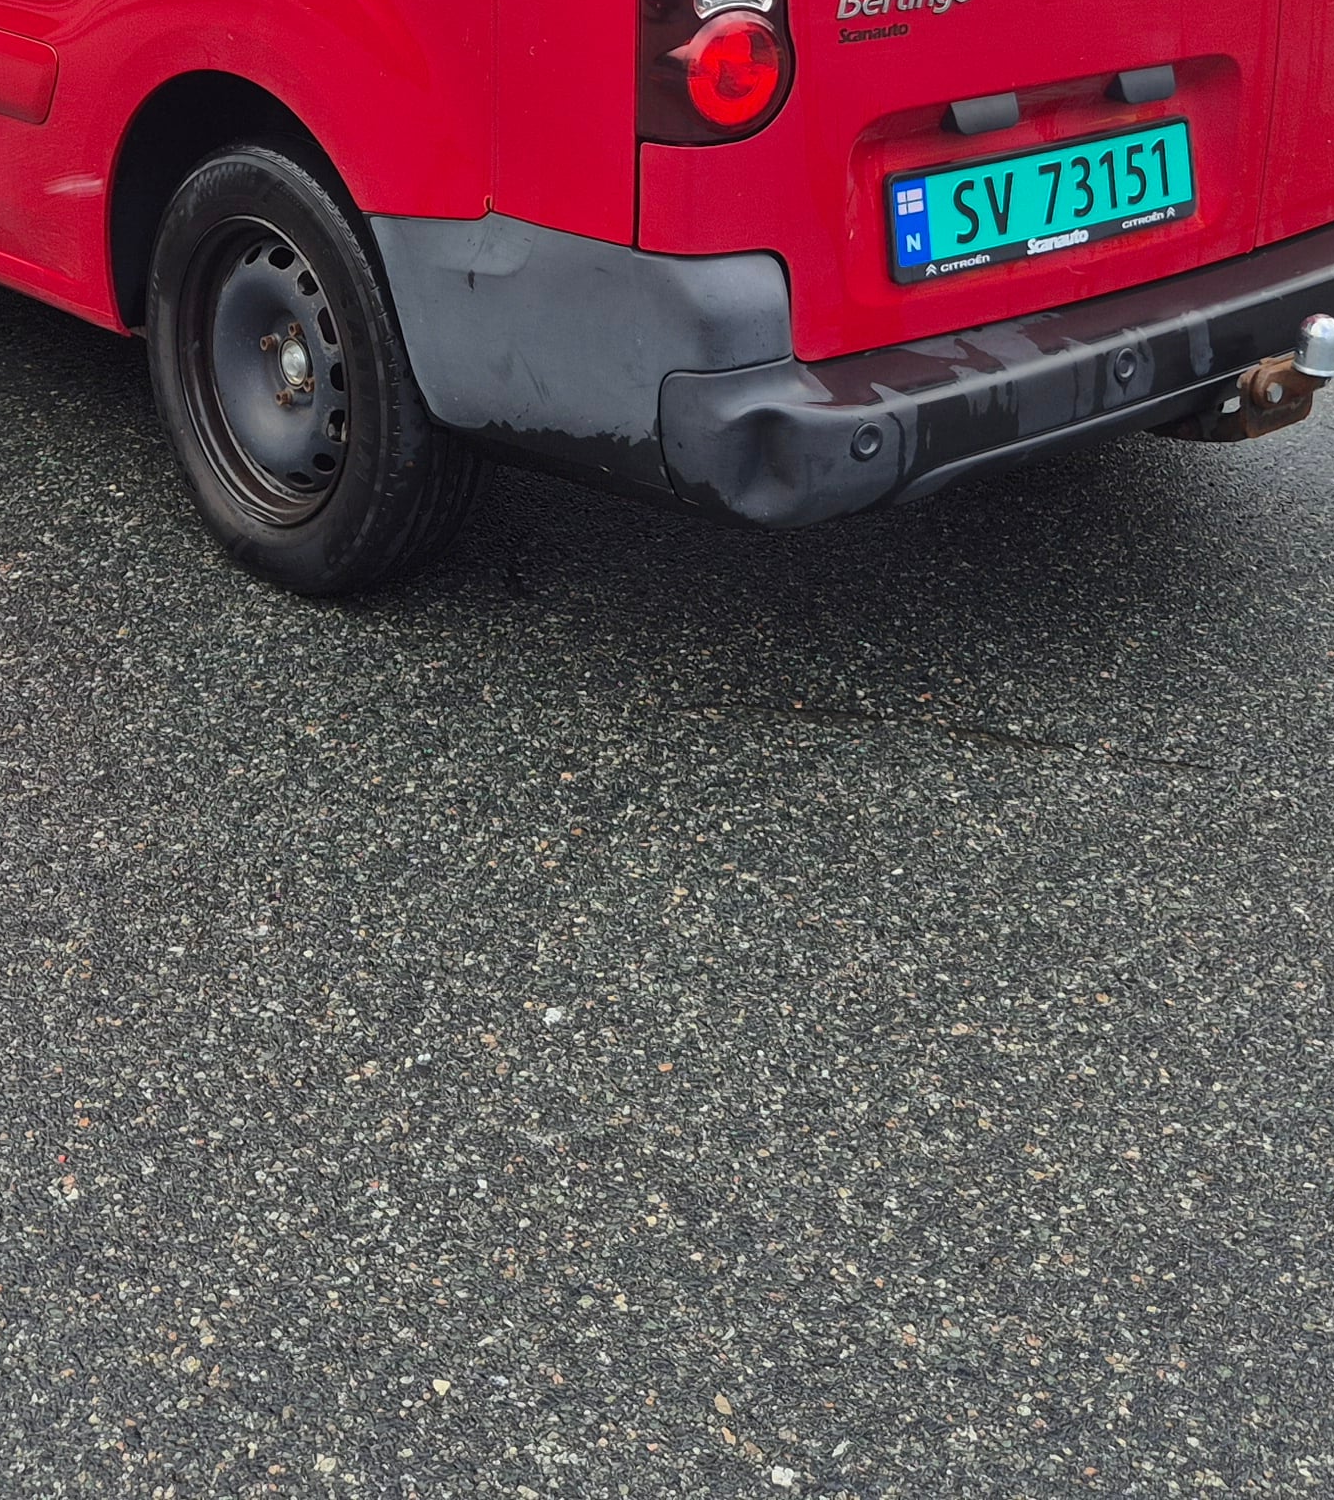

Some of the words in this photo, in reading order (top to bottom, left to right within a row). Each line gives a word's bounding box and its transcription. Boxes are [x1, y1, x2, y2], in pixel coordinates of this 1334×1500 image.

[838, 23, 909, 43] Scanauto
[952, 172, 1014, 245] SV
[1038, 138, 1170, 225] 73151
[906, 233, 921, 252] N
[940, 254, 991, 273] CITROËN
[1027, 228, 1089, 256] Scanauto
